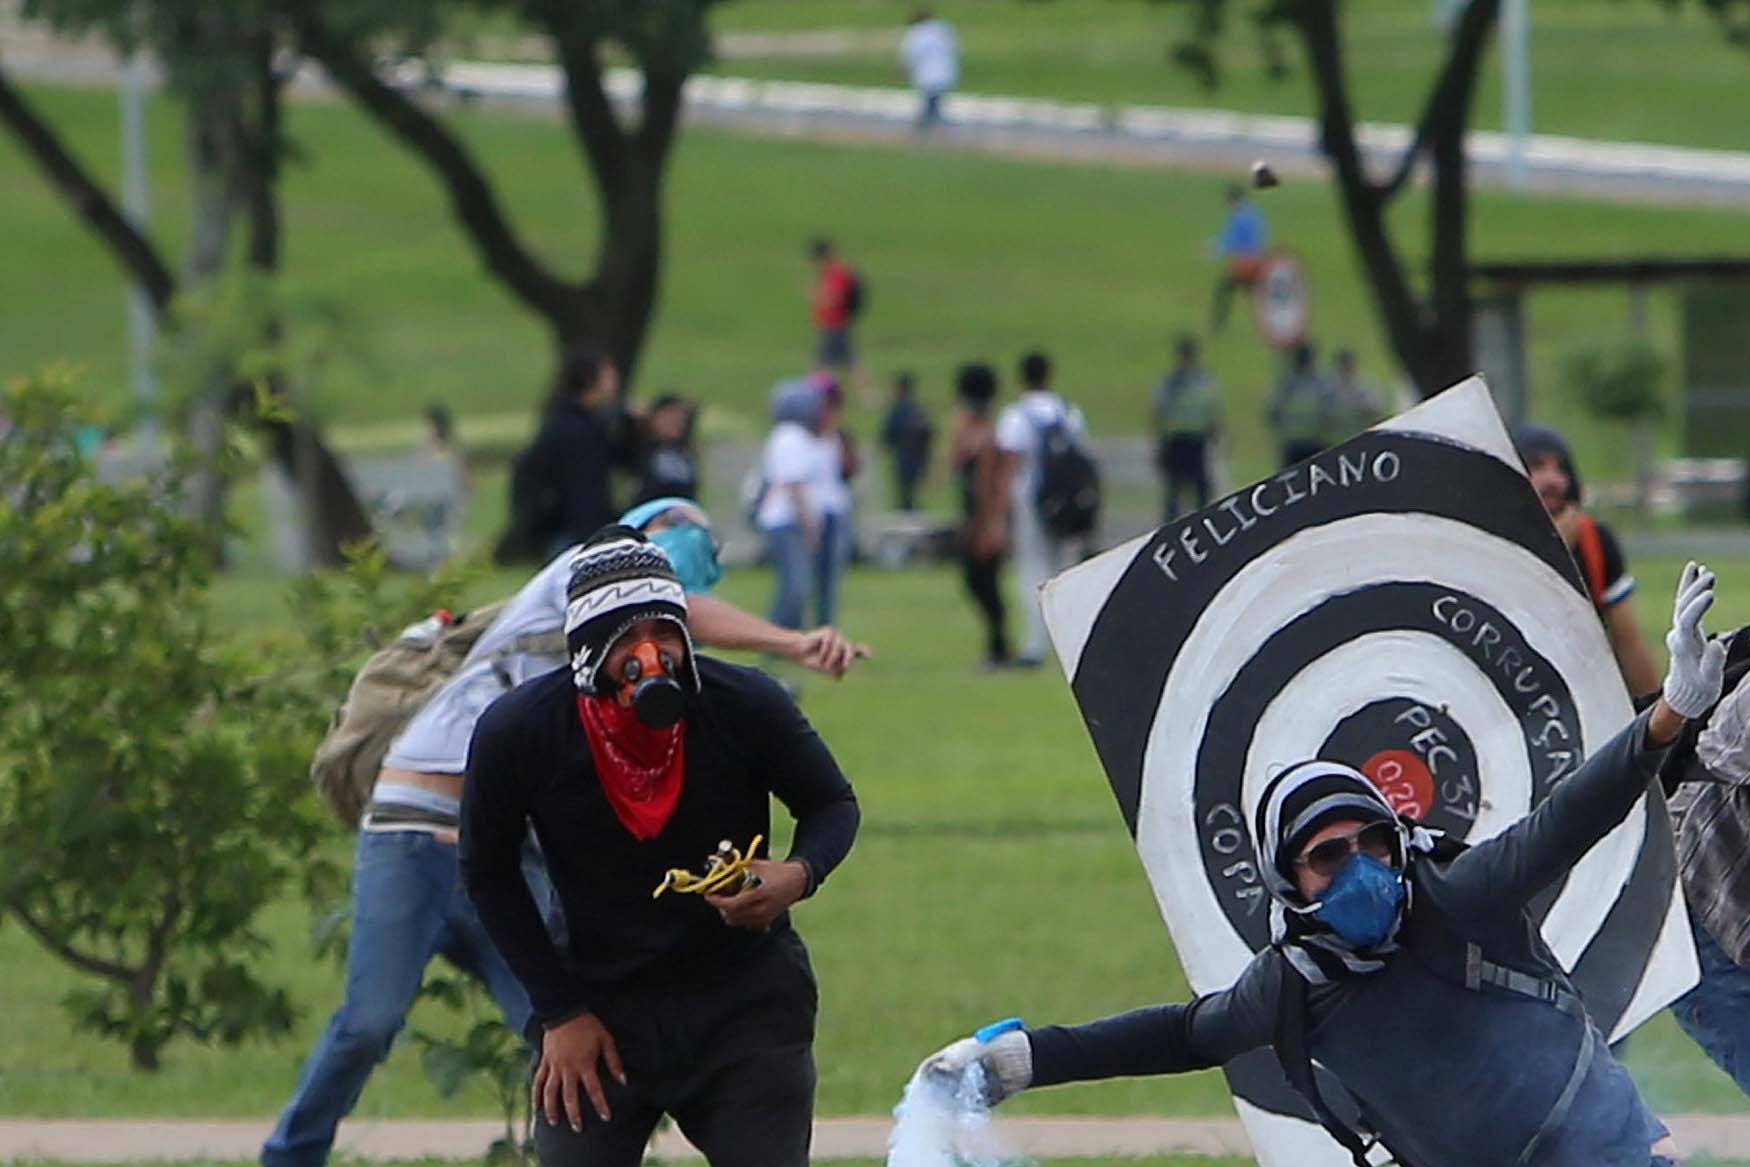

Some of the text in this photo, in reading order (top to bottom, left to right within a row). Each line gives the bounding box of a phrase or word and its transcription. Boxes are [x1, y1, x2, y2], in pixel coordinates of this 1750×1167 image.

[1153, 451, 1400, 581] FELICIANO
[1433, 596, 1583, 783] CORRUPÇÃ
[1394, 705, 1478, 820] PEC 37
[1206, 803, 1264, 916] COPA
